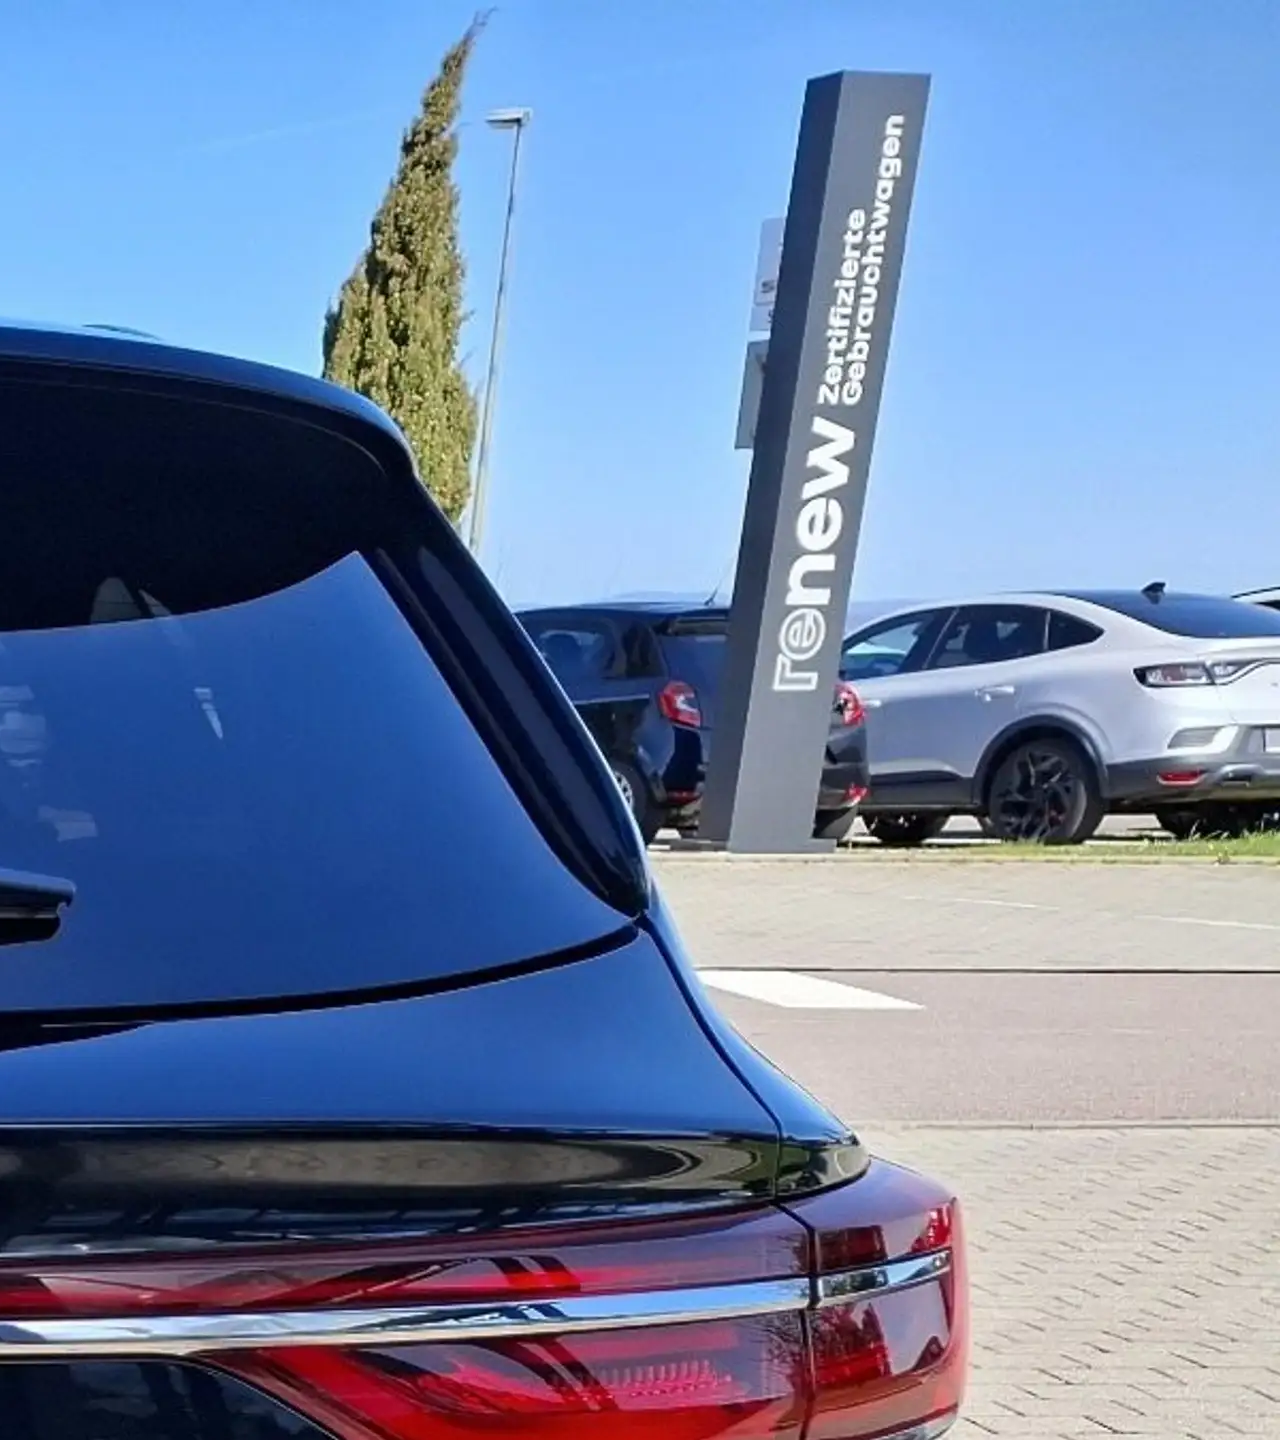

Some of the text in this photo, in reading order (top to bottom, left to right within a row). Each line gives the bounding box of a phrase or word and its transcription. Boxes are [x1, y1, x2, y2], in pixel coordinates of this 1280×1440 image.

[817, 207, 867, 406] Zertifizierte
[841, 113, 906, 406] Gebrauchtwagen
[772, 416, 856, 691] renew
